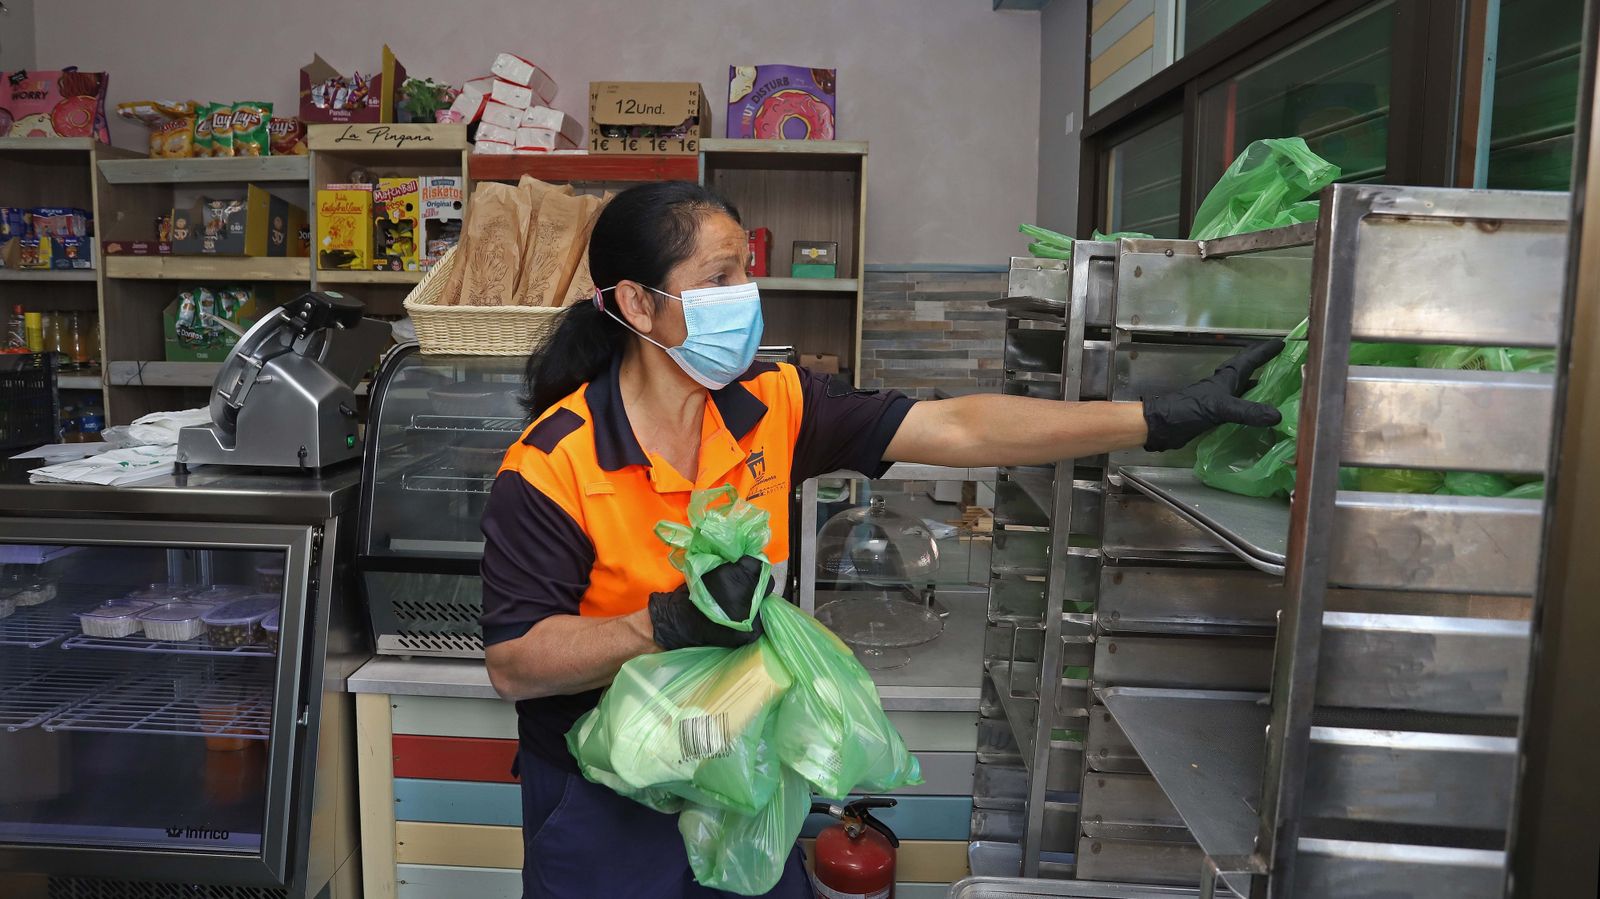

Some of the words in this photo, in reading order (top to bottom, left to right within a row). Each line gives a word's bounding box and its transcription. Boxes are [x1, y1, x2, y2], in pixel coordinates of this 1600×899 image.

[752, 76, 790, 104] DISTURB
[335, 125, 361, 142] La
[366, 126, 434, 147] Pingana
[592, 138, 609, 151] 1€
[620, 139, 638, 151] 1€
[649, 139, 667, 151] 1€
[678, 139, 696, 152] 1€
[421, 186, 463, 200] Risketos
[426, 200, 452, 208] Original
[180, 328, 203, 340] Doritos
[185, 825, 229, 840] Infrico
